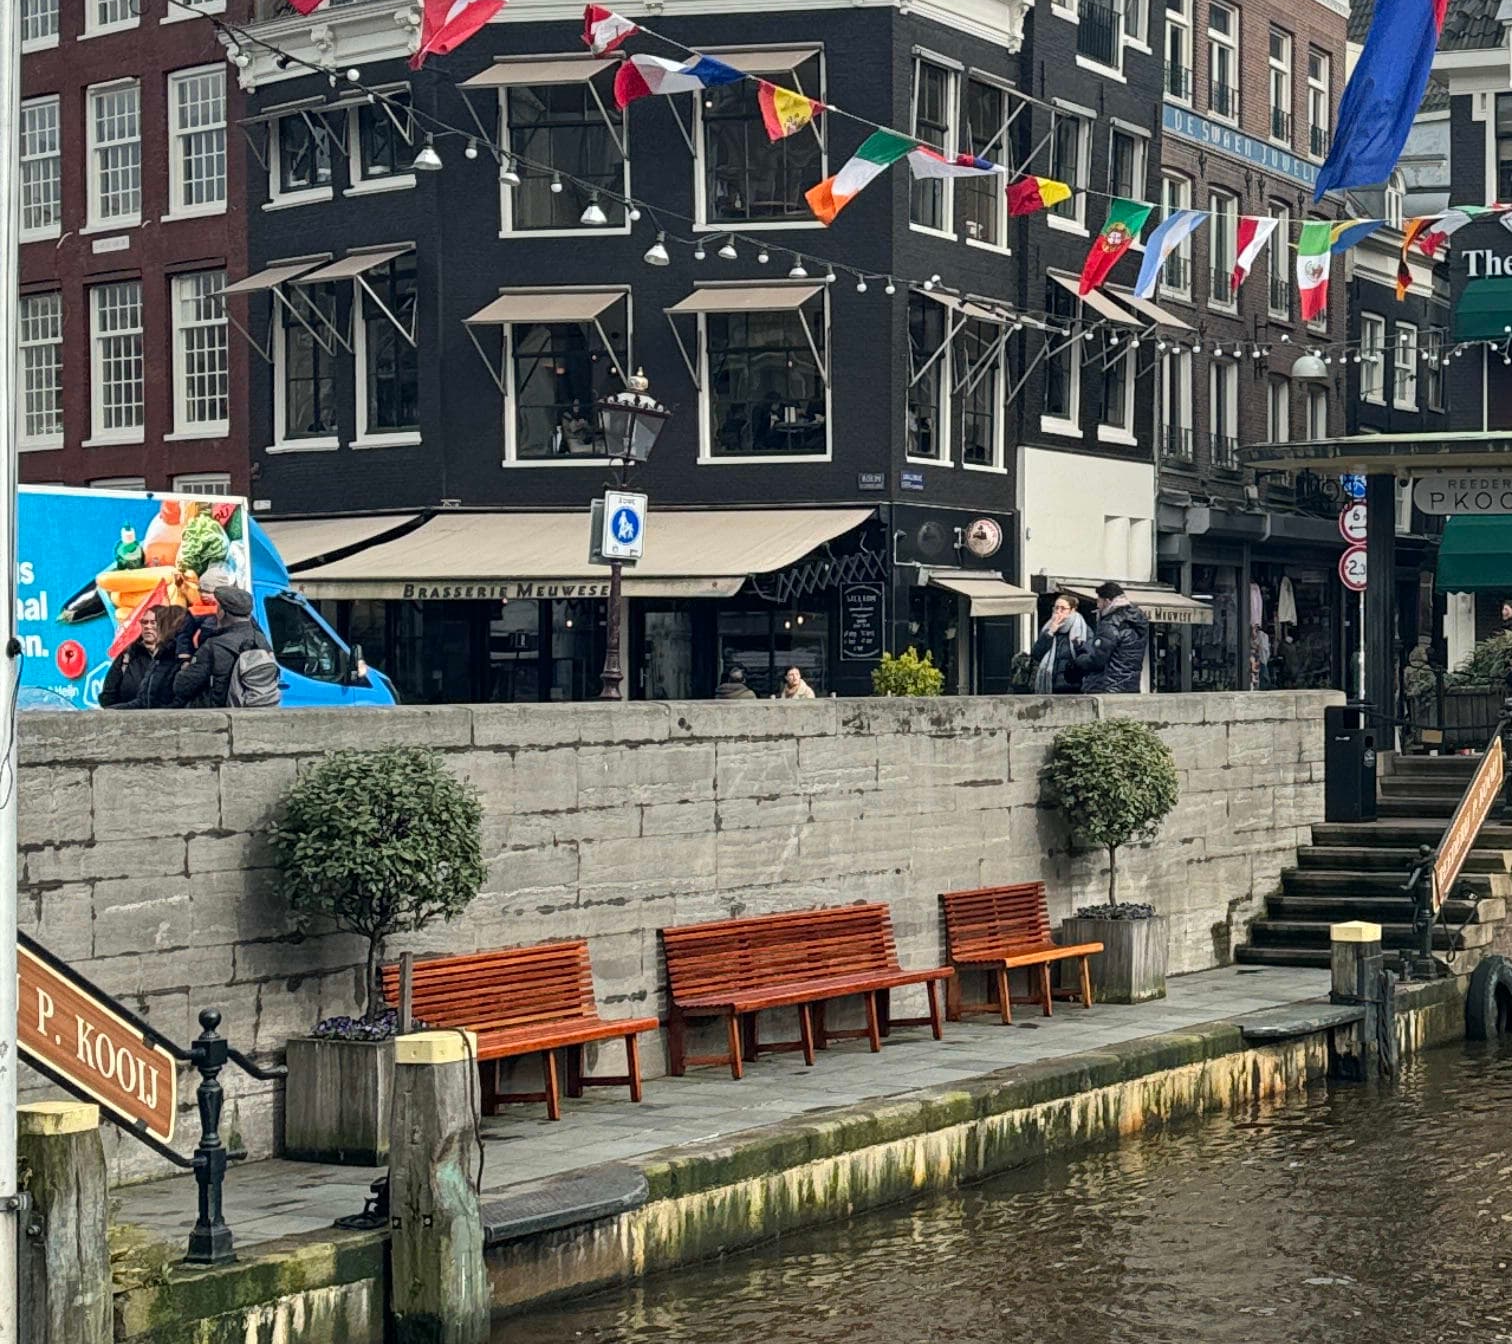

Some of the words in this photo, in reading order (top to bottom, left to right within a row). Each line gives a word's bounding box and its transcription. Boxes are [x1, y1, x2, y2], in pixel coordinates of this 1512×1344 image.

[1174, 109, 1194, 134] DE
[403, 583, 508, 598] BRASSERIE
[516, 582, 610, 597] MEUWESE
[36, 986, 62, 1046] P.
[75, 1013, 159, 1110] KOOIJ
